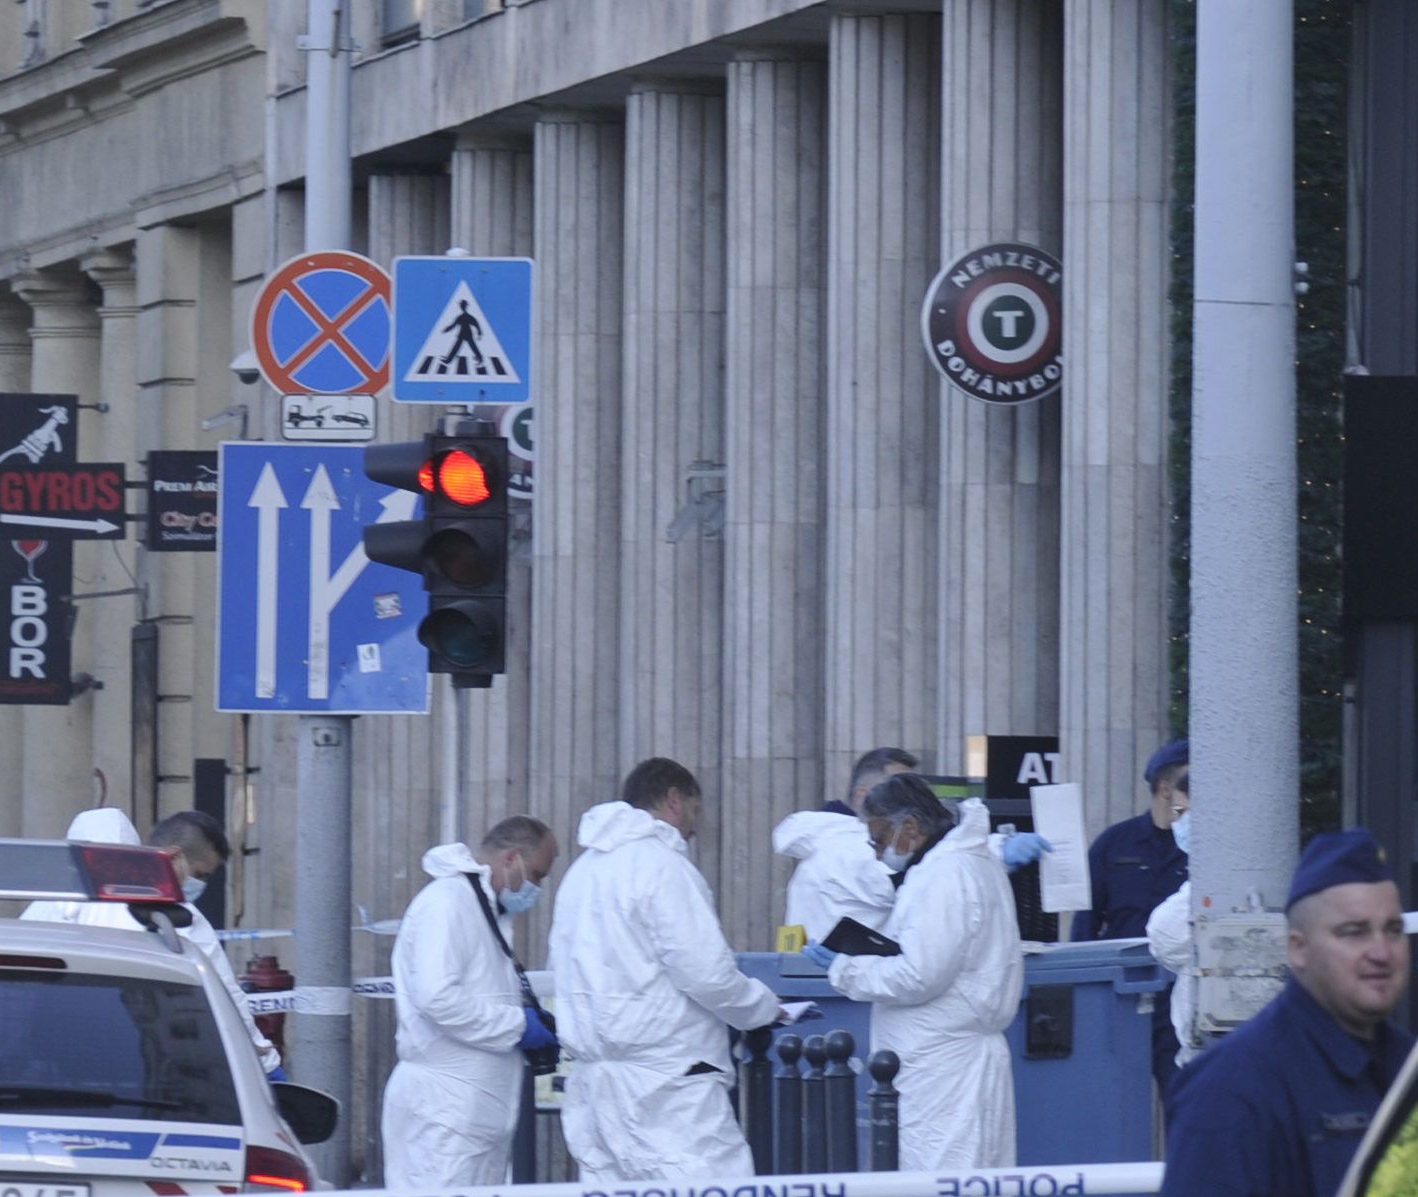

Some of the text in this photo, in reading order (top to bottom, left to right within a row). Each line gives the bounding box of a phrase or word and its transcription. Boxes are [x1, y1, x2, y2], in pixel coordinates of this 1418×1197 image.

[951, 252, 1061, 288] NEMZETI
[937, 339, 1063, 396] DOHÁNYBO
[0, 471, 121, 511] GYROS
[9, 585, 48, 679] BOR
[1017, 752, 1060, 784] AT
[150, 1156, 232, 1172] OCTAVIA
